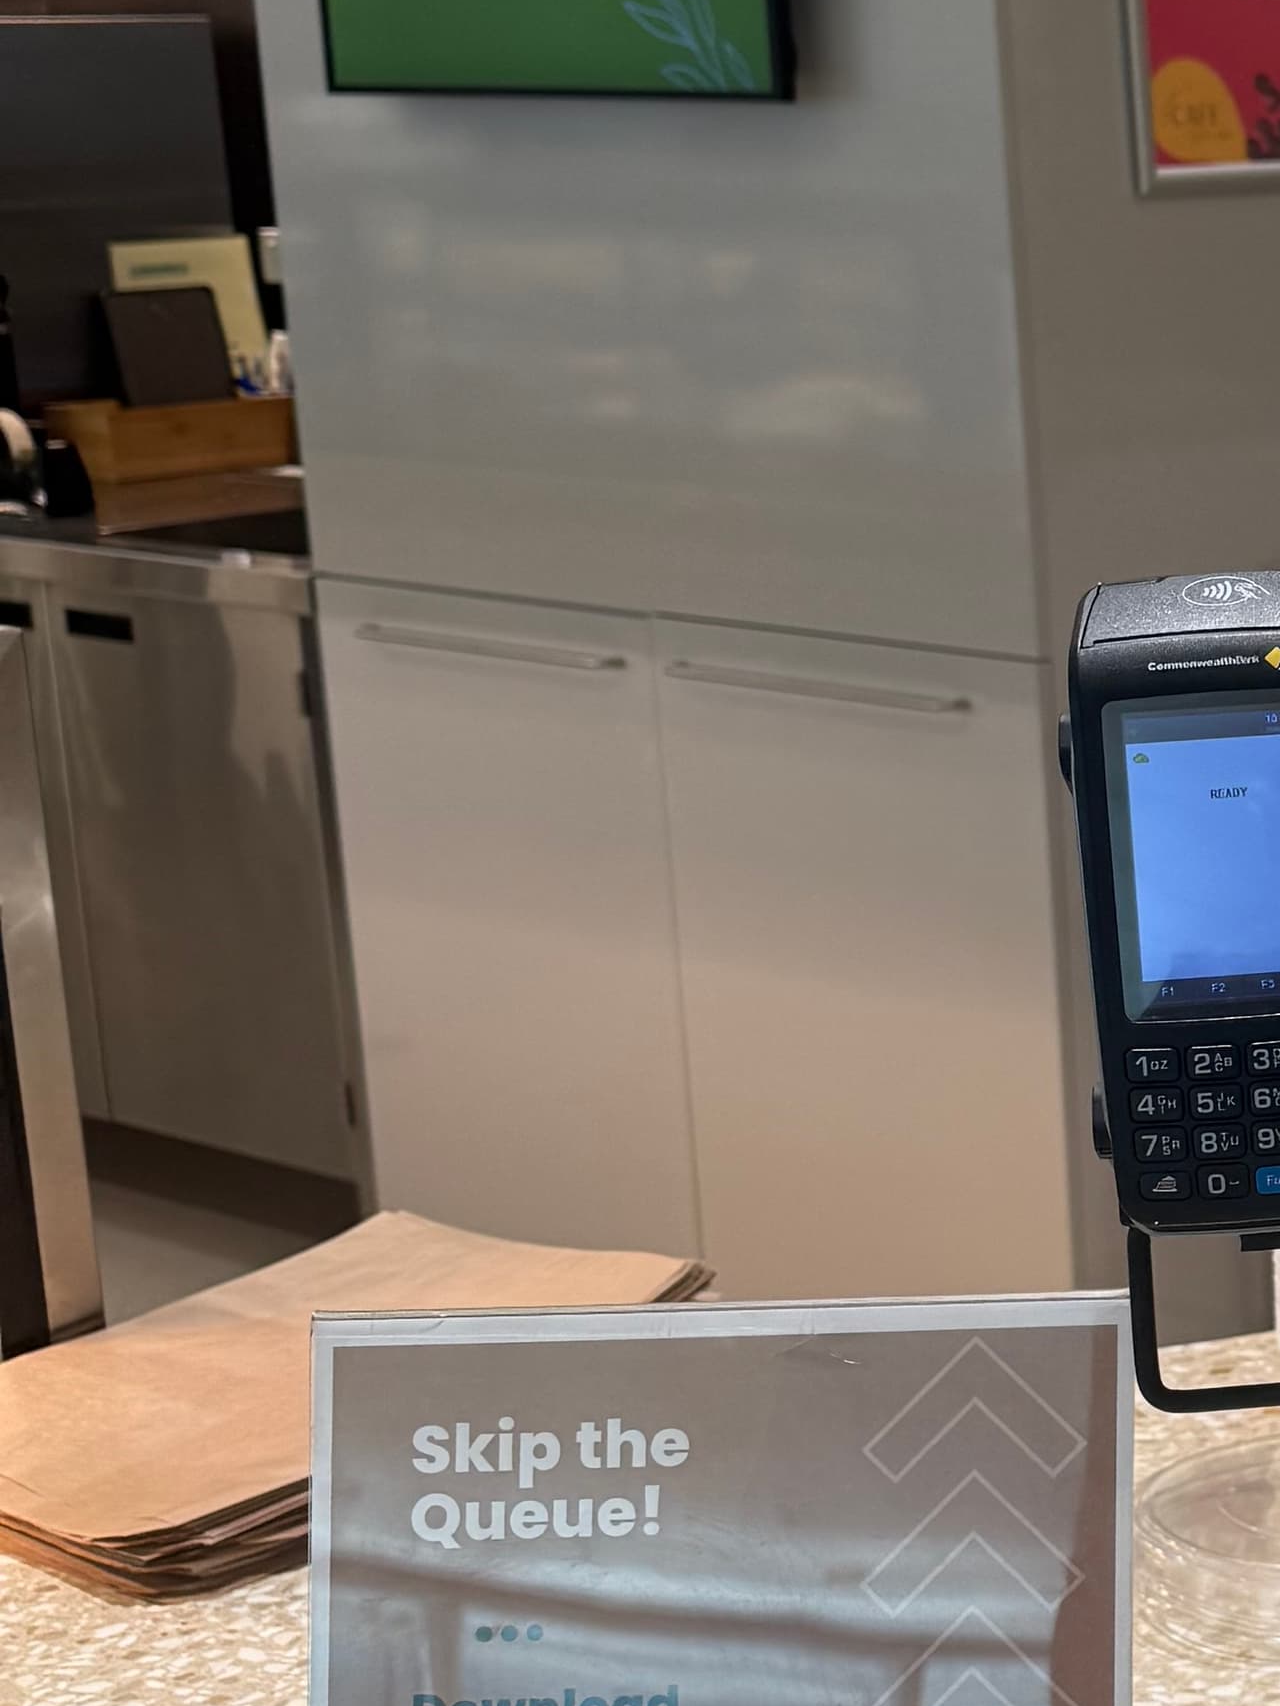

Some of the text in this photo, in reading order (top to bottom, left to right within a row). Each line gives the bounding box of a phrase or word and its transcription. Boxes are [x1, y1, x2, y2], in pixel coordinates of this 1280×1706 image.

[1208, 786, 1249, 801] READY
[1161, 986, 1175, 997] F1
[1211, 982, 1226, 994] F2
[411, 1417, 690, 1489] Skip the
[410, 1484, 661, 1550] Queue!
